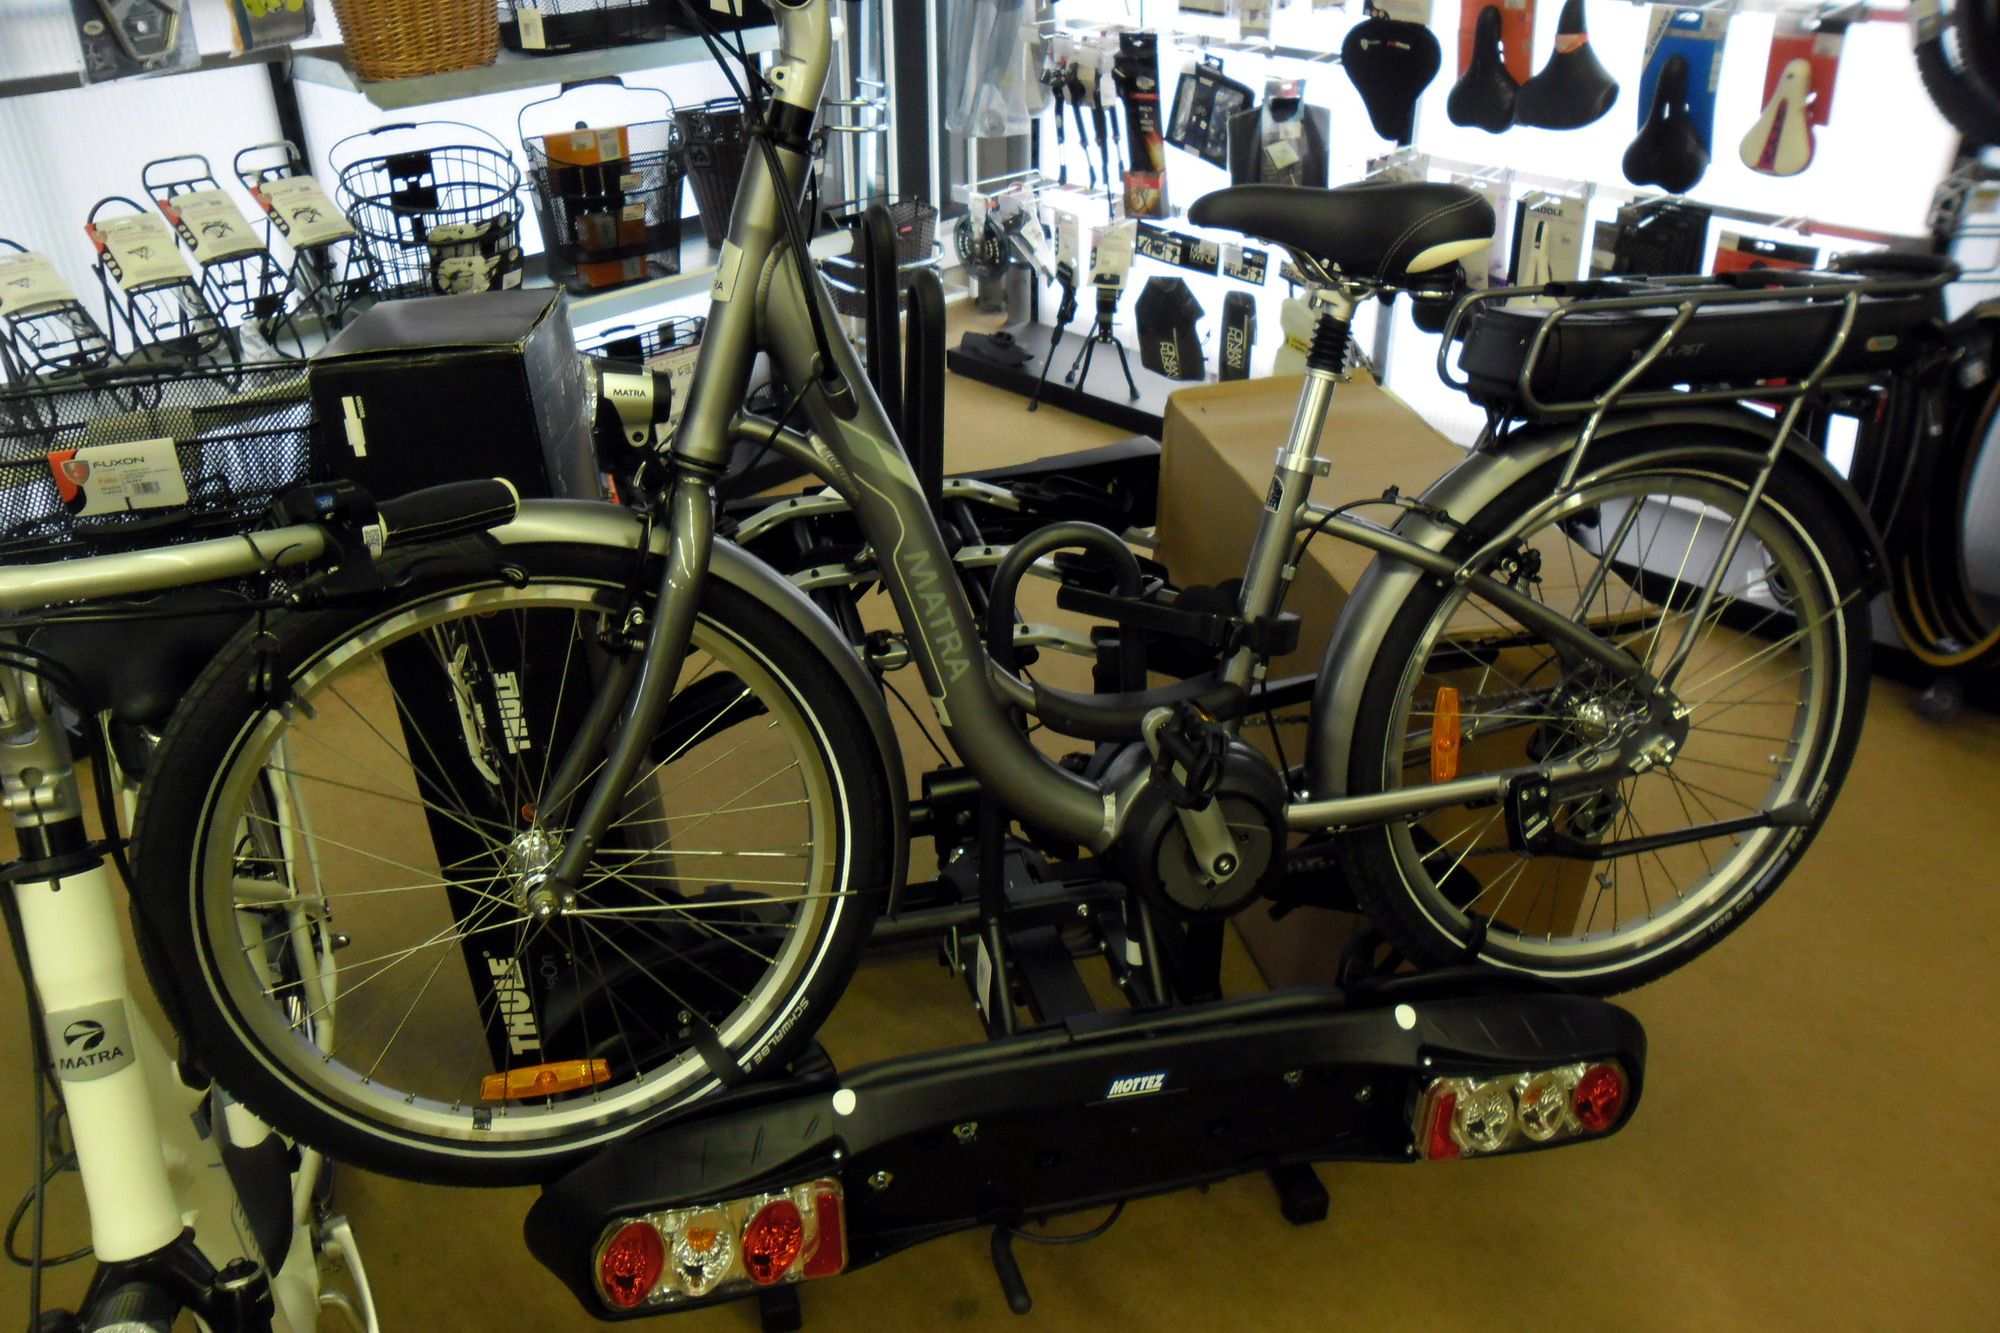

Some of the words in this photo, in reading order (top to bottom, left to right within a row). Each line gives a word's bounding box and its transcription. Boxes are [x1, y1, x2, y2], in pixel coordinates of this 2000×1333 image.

[1529, 206, 1564, 217] ADDLE
[613, 389, 647, 398] MATRA
[92, 456, 145, 469] FUXON
[904, 550, 971, 682] MATRA
[493, 671, 531, 754] THULE
[488, 956, 541, 1055] THULE
[753, 996, 810, 1065] SCHWALBE
[59, 1046, 124, 1073] MATRA
[1109, 1074, 1166, 1096] MOTTEZ
